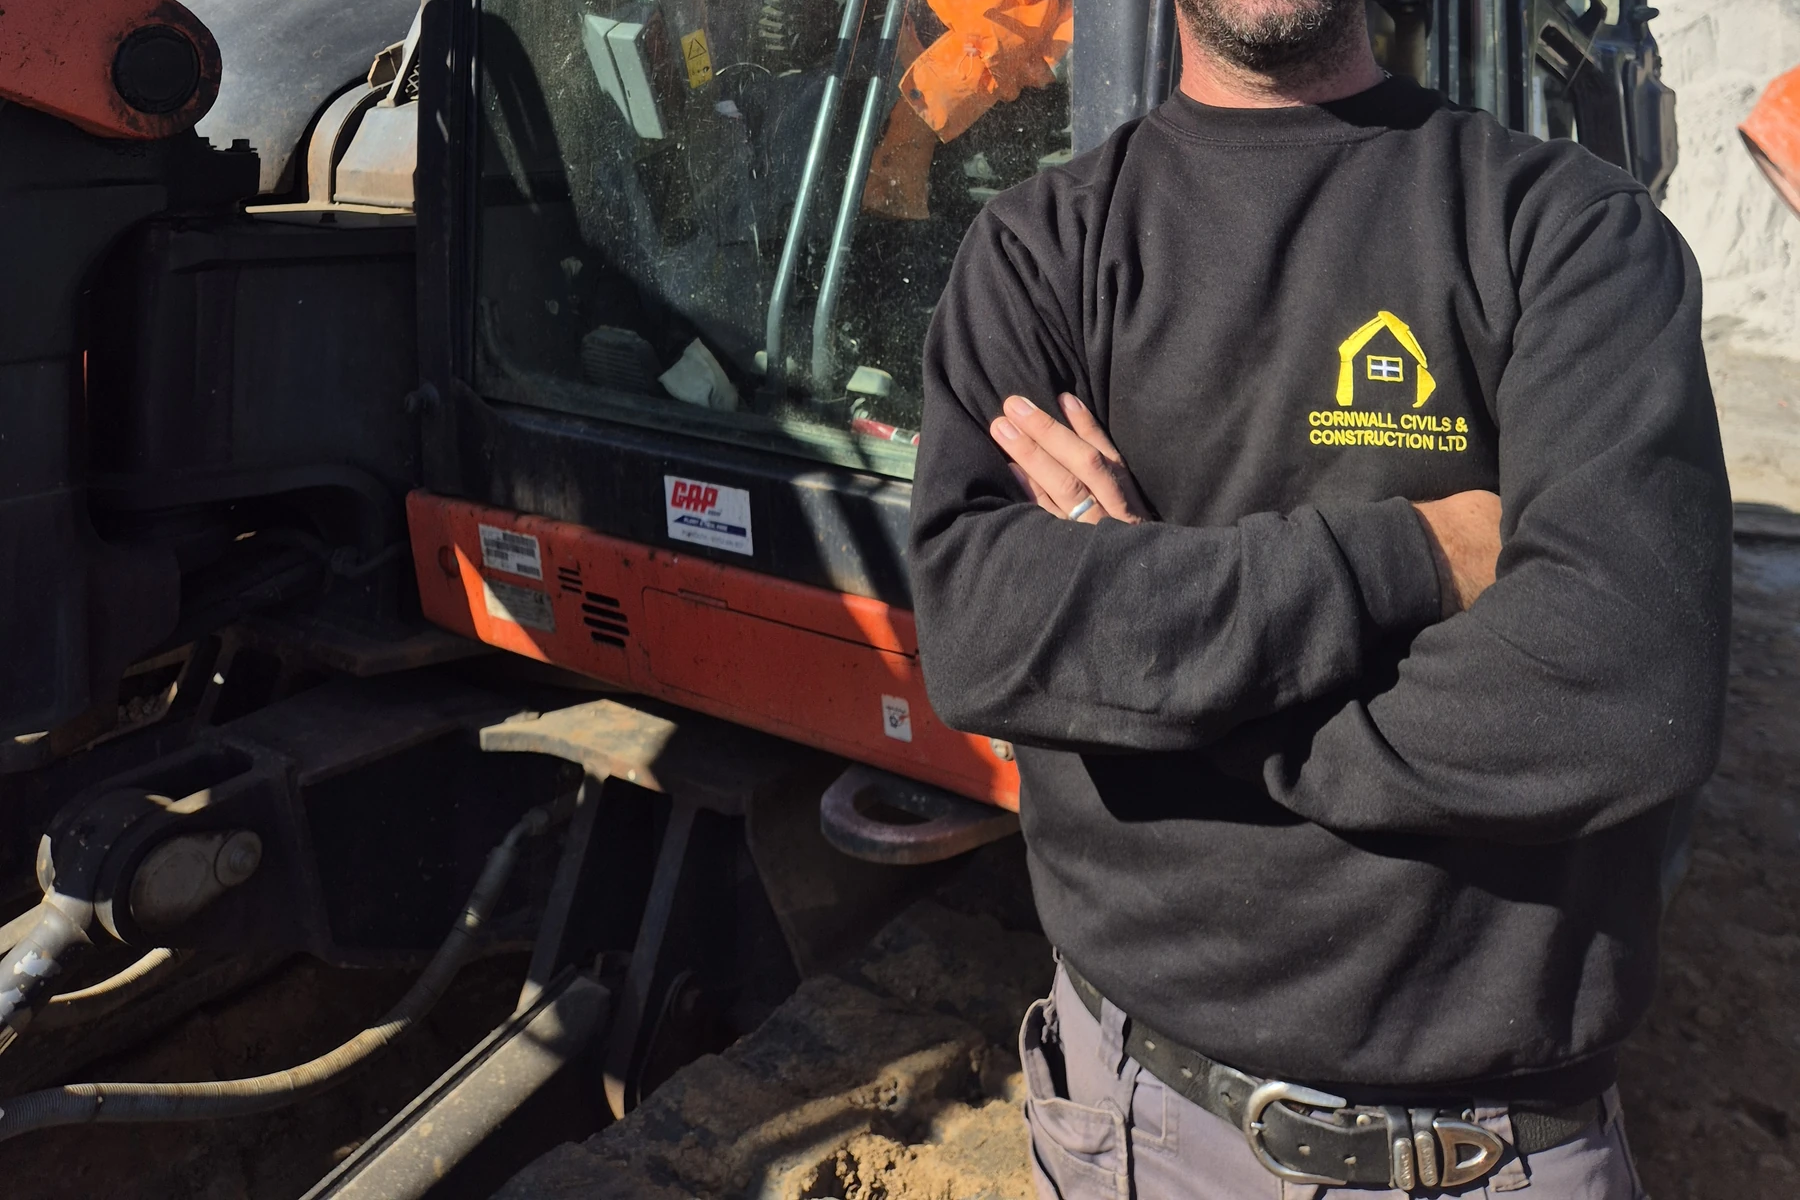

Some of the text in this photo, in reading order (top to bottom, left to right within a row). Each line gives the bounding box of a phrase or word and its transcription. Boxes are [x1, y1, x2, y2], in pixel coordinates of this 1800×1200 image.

[1309, 411, 1468, 433] CORNWALL CIVILS &
[1309, 429, 1468, 452] CONSTRUCTION LTD
[670, 481, 719, 514] GAP
